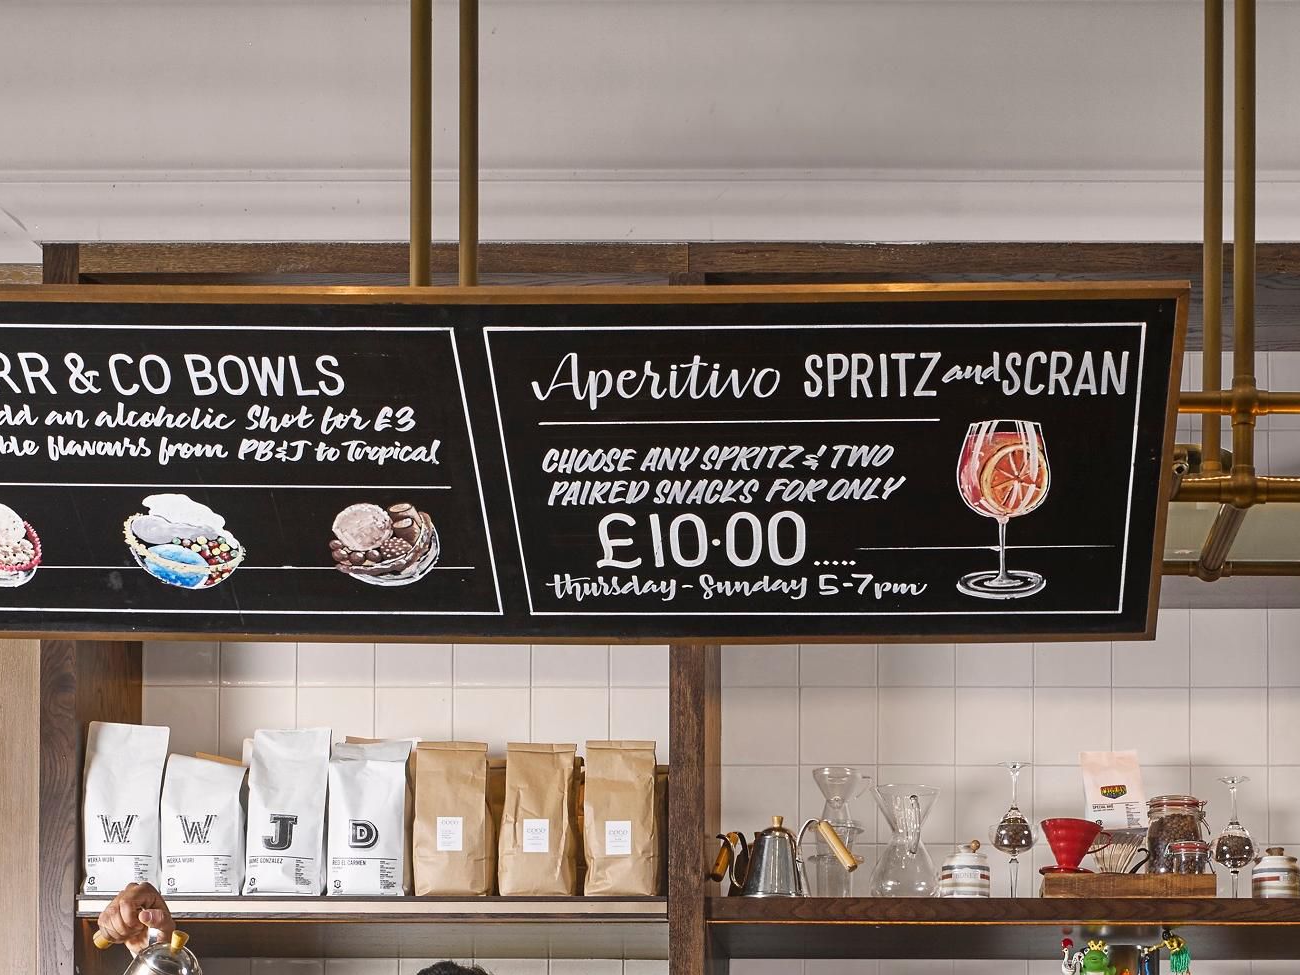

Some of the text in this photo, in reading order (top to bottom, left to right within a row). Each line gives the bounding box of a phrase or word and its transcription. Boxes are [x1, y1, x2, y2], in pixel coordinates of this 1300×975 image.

[64, 353, 101, 394] &
[109, 354, 171, 395] CO
[184, 354, 344, 396] BOWLS
[531, 353, 780, 410] Aperitivo
[804, 352, 941, 398] SPRITZ
[1002, 351, 1129, 396] SCRAN
[45, 410, 89, 428] an
[95, 402, 236, 429] alcoholic
[321, 406, 371, 435] for
[374, 406, 416, 432] £3
[48, 436, 151, 461] flavours
[159, 437, 228, 465] from
[314, 442, 340, 461] to
[342, 440, 440, 465] Tropical
[542, 445, 894, 474] CHOOSE ANY SPRITZ TWO
[548, 476, 906, 506] PAIRED SNACKS FOR ONLY
[699, 574, 807, 599] Sunday
[262, 813, 298, 850] J
